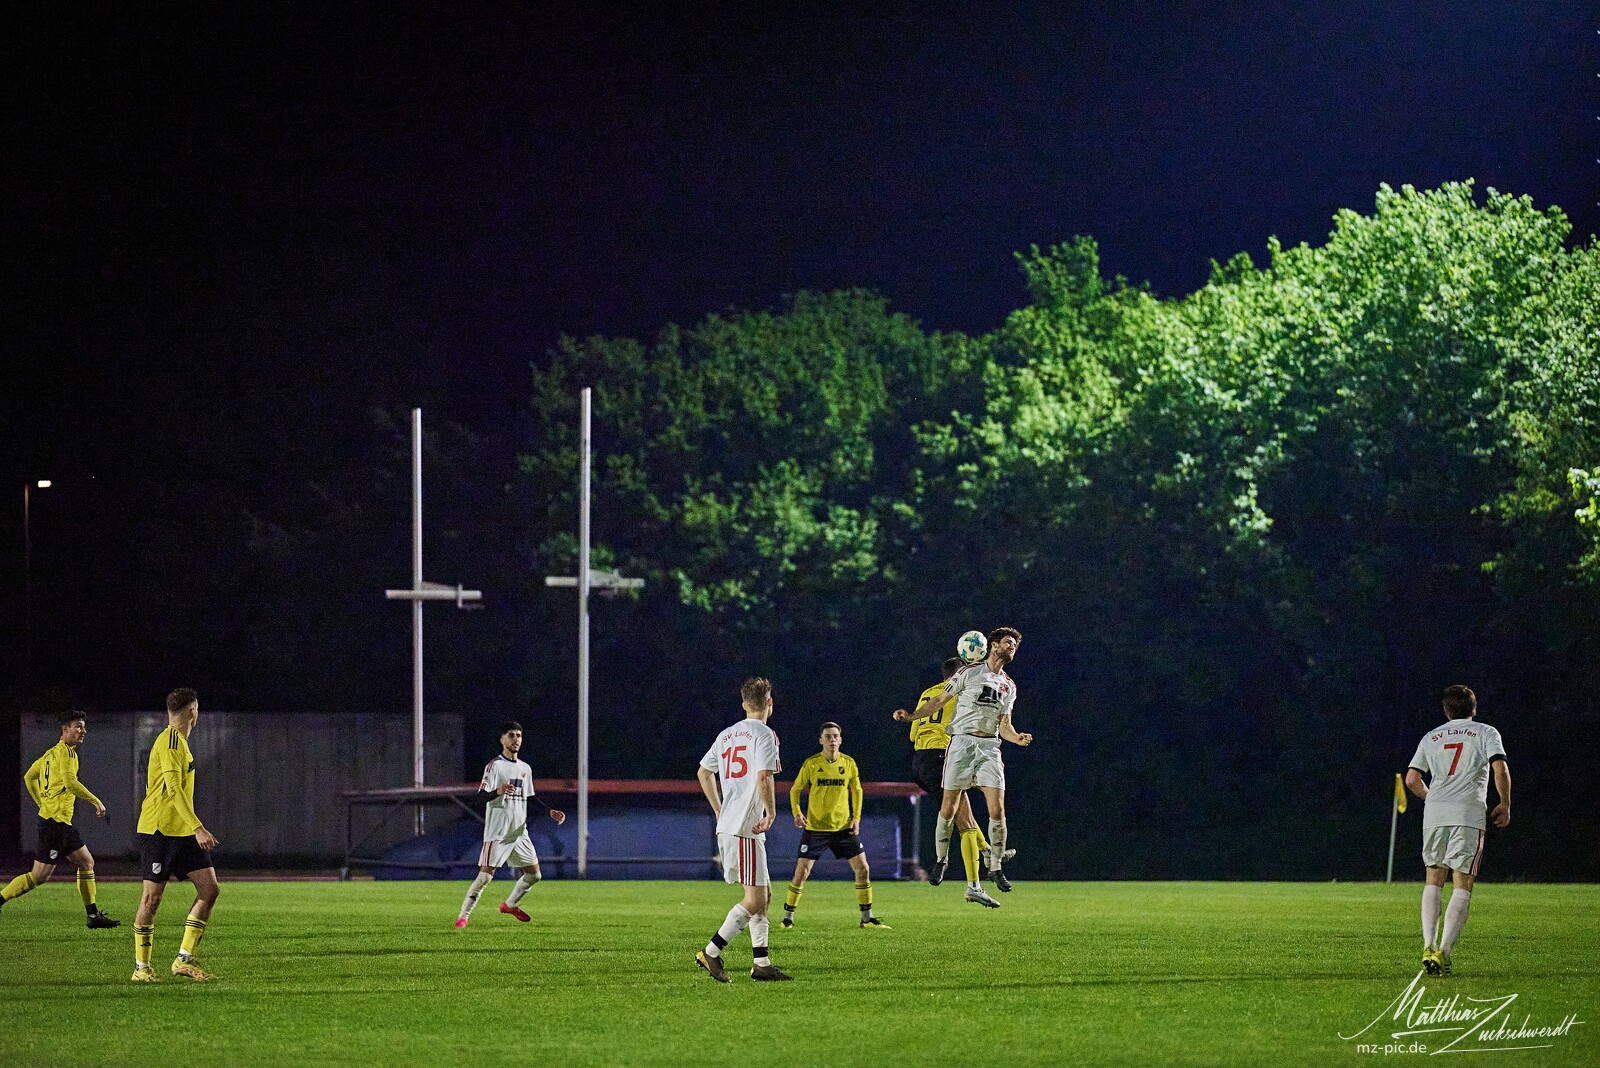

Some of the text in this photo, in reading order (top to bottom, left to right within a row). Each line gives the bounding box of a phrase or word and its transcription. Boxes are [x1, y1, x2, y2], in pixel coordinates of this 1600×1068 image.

[722, 733, 733, 743] SV
[1431, 729, 1477, 742] SV Laufen
[721, 745, 748, 779] 15
[1443, 742, 1464, 776] 7
[44, 760, 50, 790] 9
